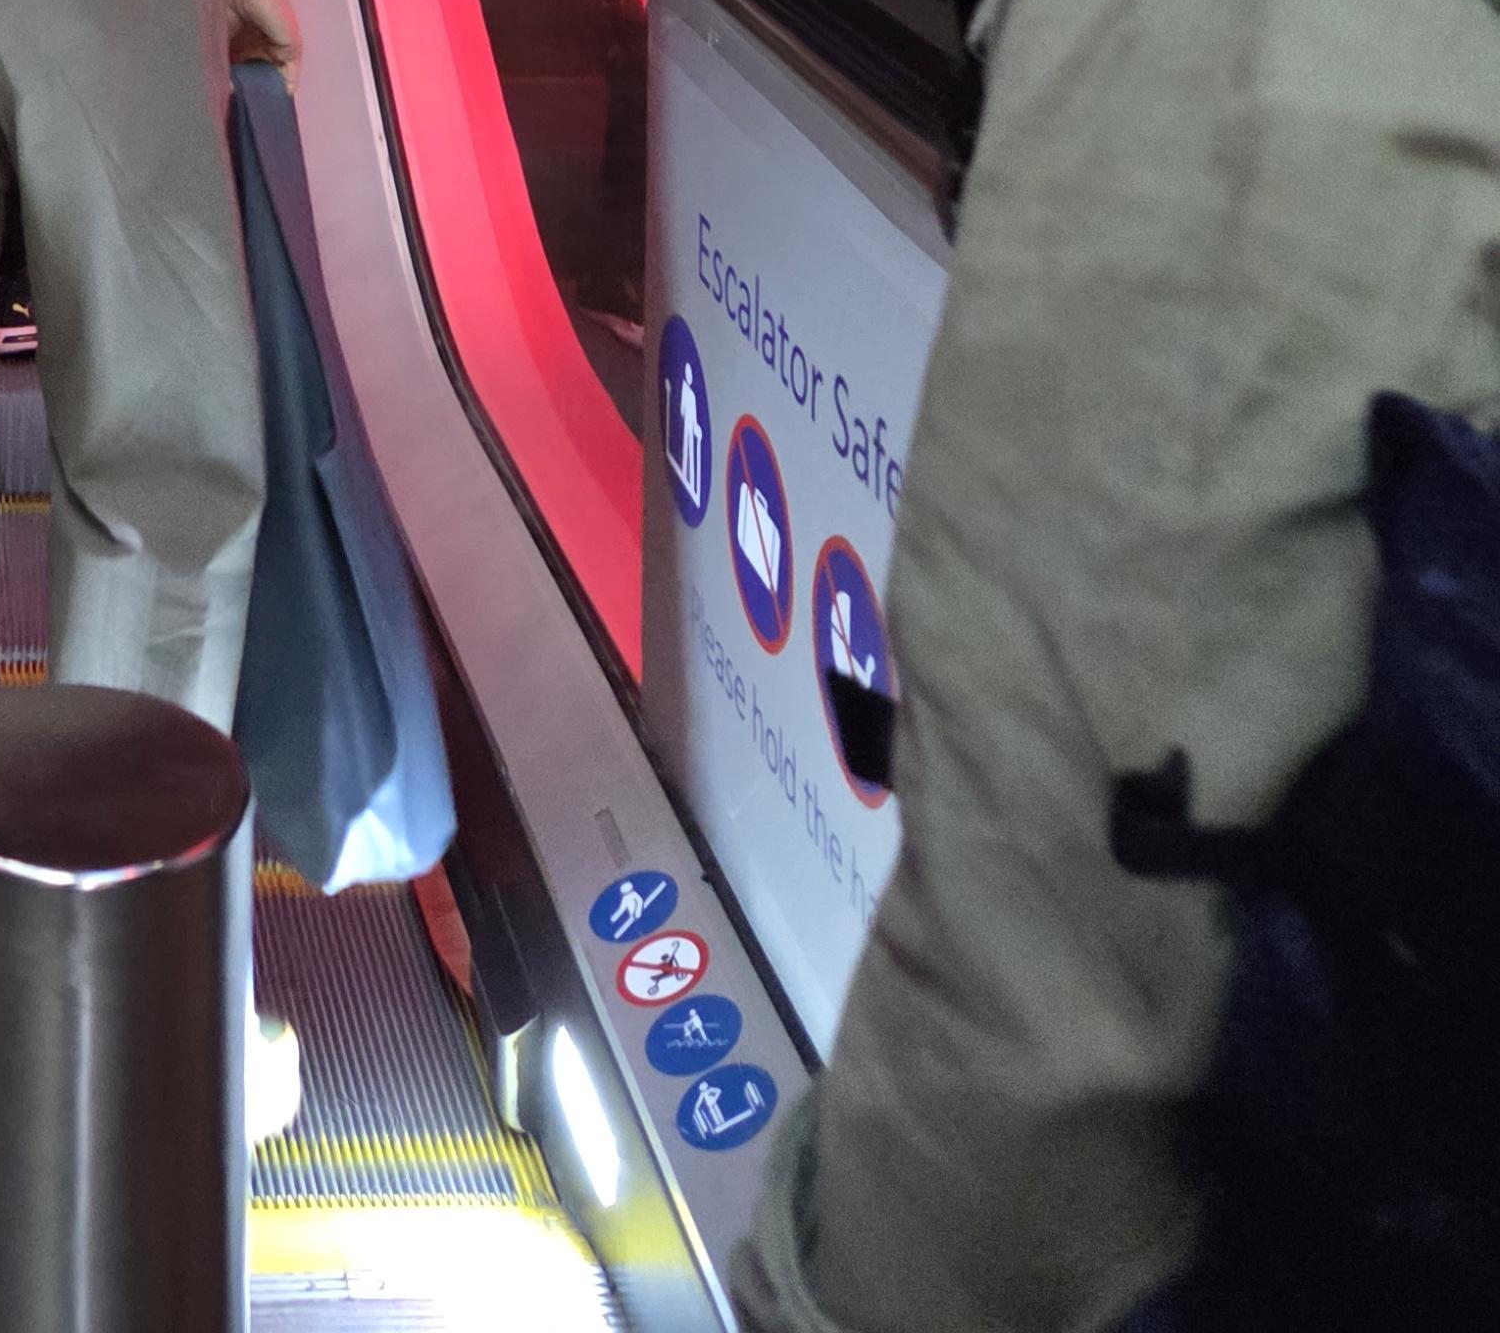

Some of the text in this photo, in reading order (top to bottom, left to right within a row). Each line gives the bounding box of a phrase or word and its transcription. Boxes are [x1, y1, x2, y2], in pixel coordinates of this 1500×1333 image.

[698, 212, 824, 422] Escalator
[752, 685, 797, 809] hold
[804, 779, 842, 885] the
